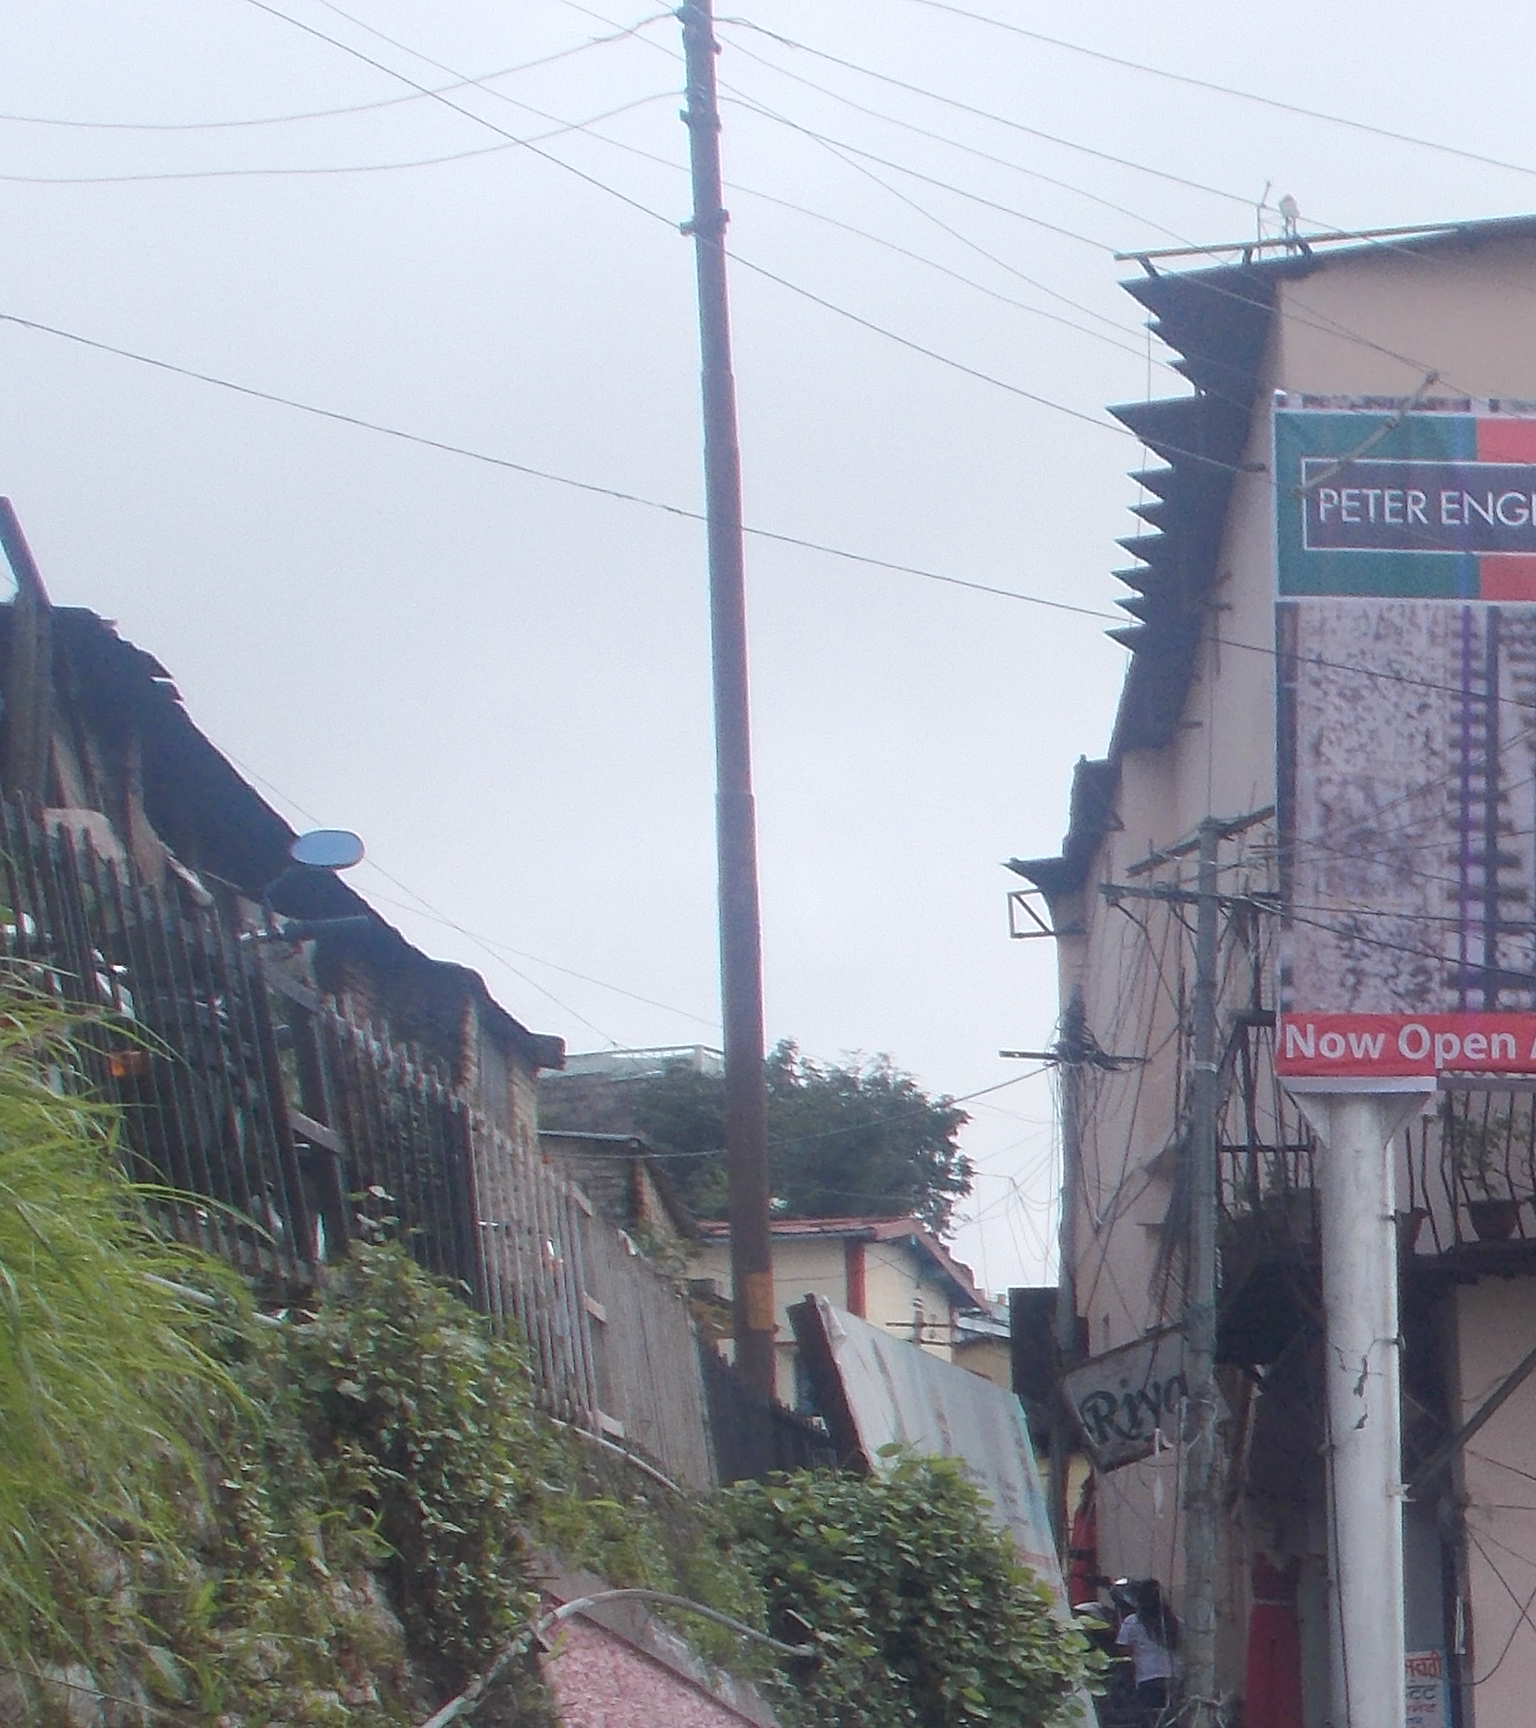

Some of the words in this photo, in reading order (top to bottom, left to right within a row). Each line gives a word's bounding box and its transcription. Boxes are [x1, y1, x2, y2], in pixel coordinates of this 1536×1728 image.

[1319, 488, 1429, 525] PETER
[1285, 1026, 1388, 1060] Now
[1396, 1023, 1516, 1069] Open
